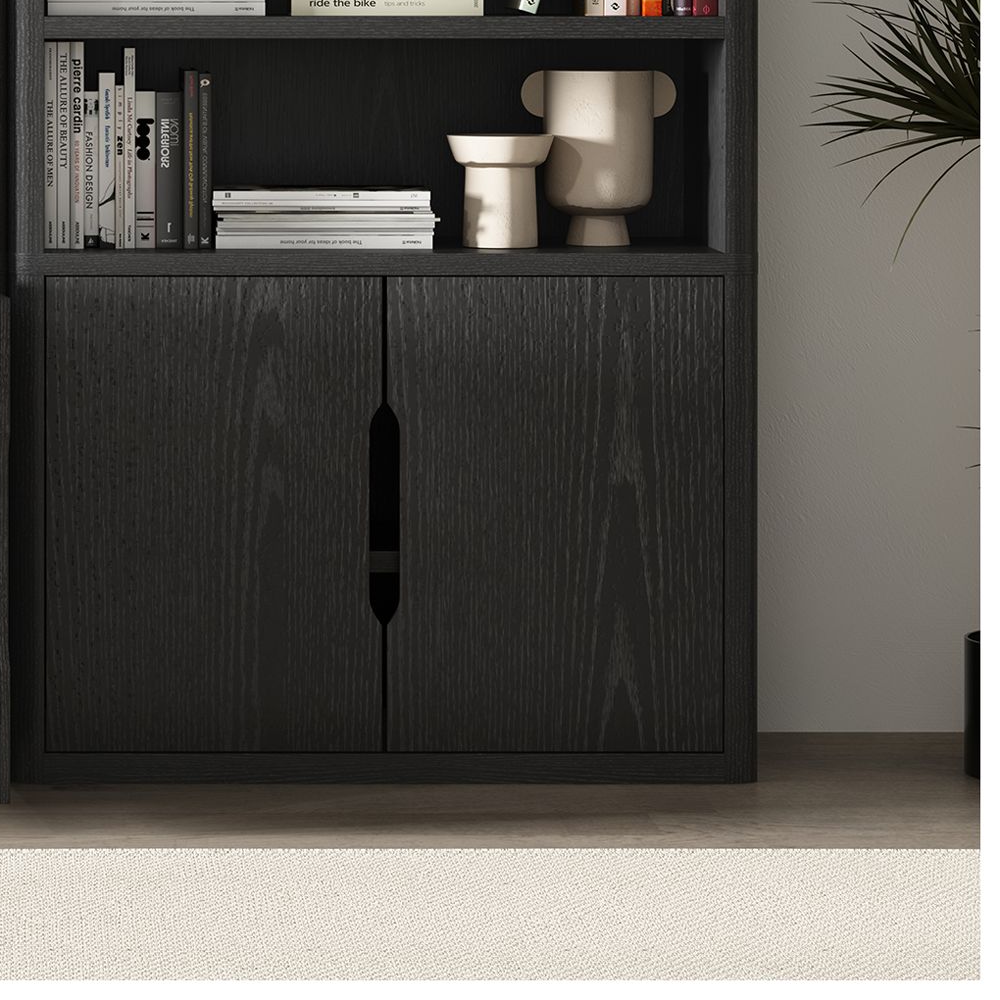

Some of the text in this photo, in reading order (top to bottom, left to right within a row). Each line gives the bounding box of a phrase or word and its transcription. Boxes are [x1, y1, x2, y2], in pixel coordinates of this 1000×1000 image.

[309, 0, 376, 7] ride the bike
[384, 0, 397, 9] tips
[59, 53, 67, 169] THE ALLURE OF BEAUTY
[71, 59, 83, 134] pierre cardin
[47, 155, 54, 166] OF
[85, 132, 93, 209] FASHION DESIGN
